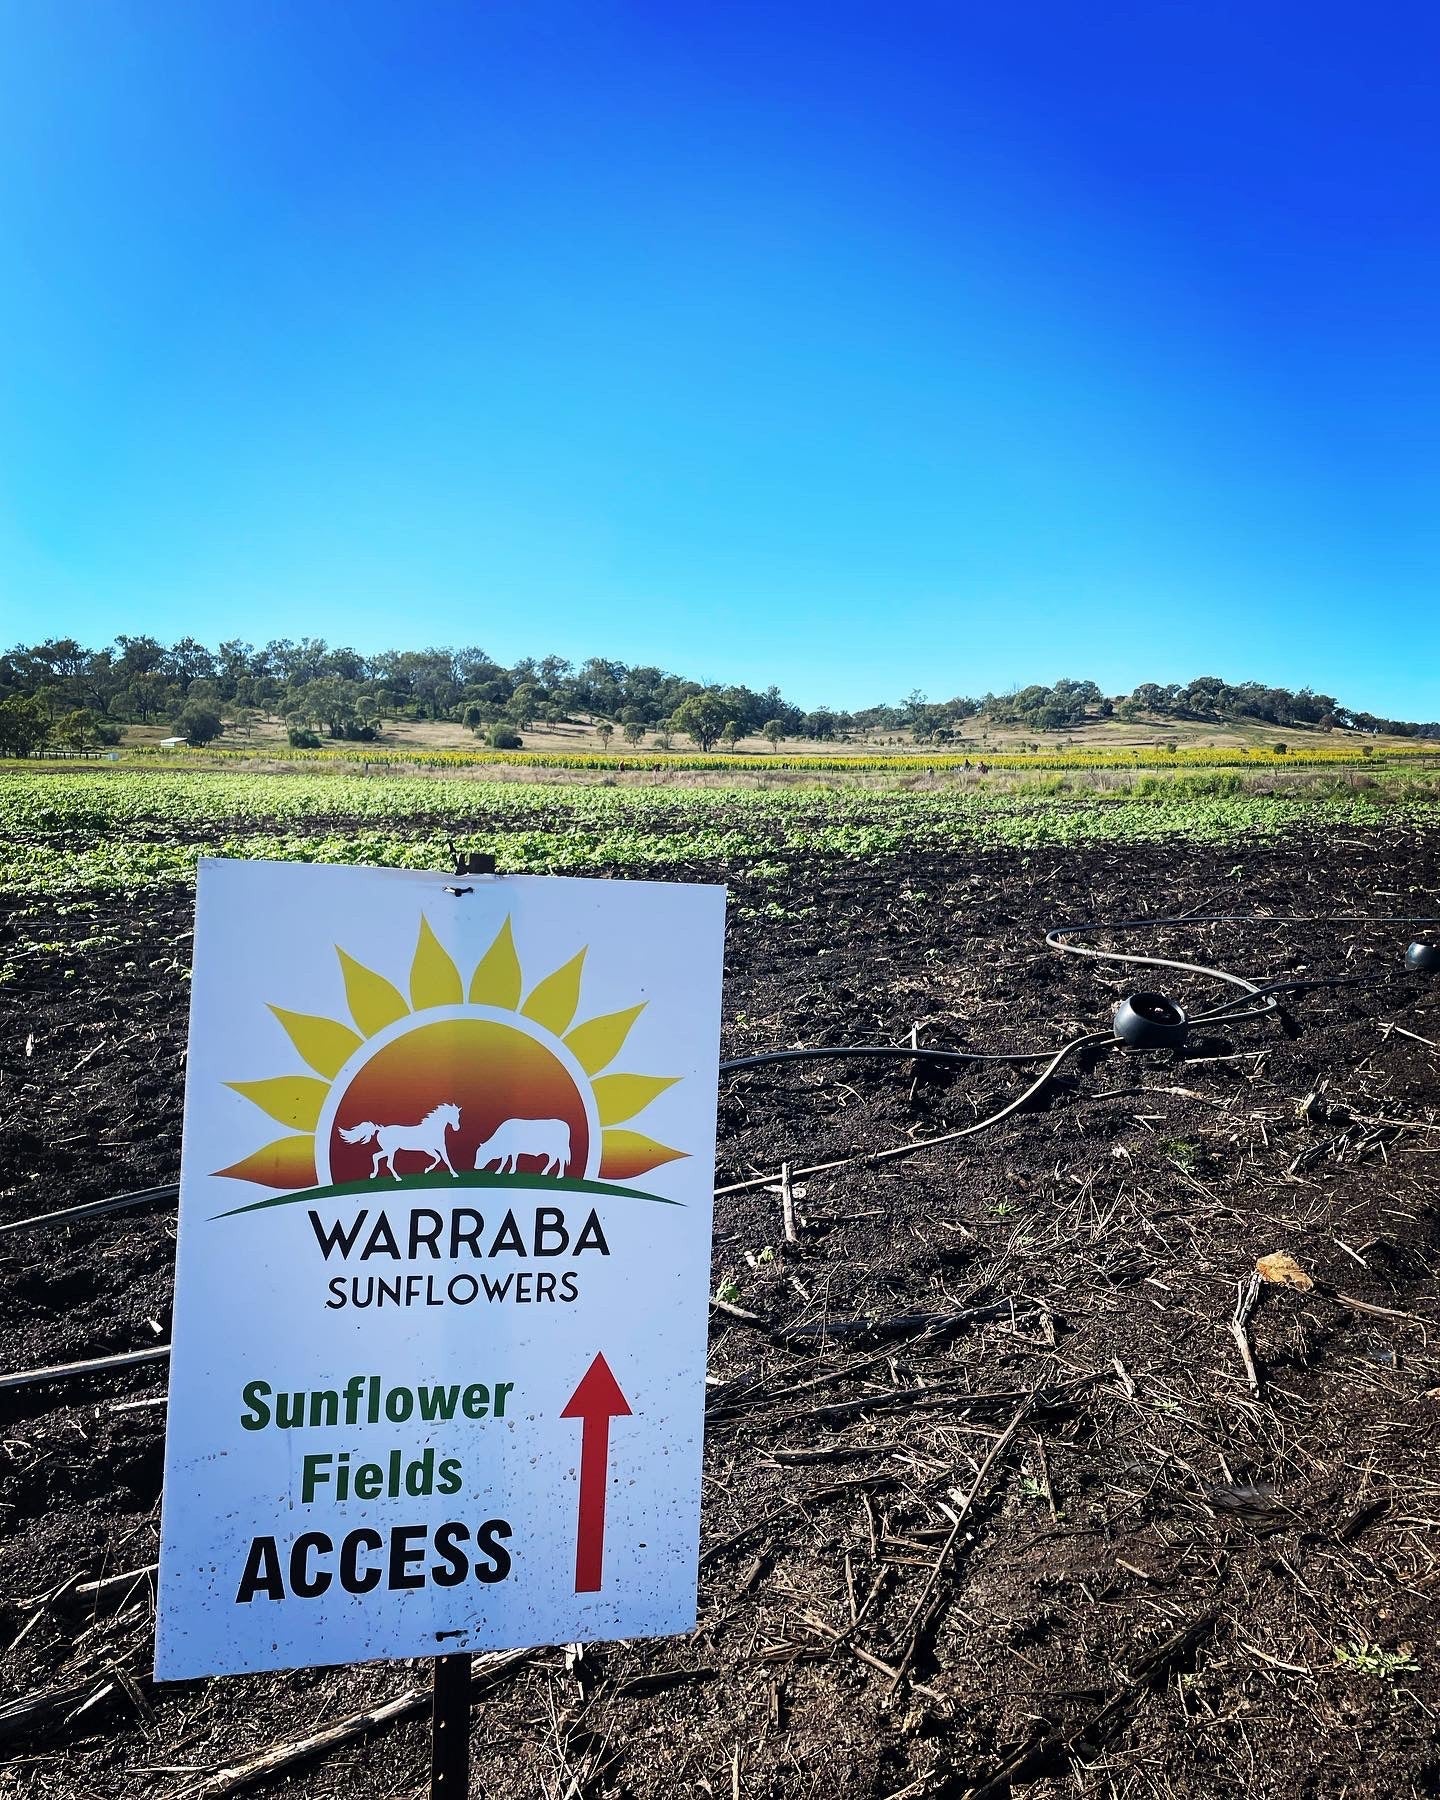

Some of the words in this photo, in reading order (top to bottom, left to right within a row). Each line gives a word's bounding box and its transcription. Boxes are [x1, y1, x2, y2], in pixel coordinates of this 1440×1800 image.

[308, 1207, 610, 1261] WARRABA
[327, 1272, 578, 1309] SUNFLOWERS
[240, 1375, 514, 1431] Sunflower
[301, 1448, 463, 1504] Fields
[235, 1519, 513, 1604] ACCESS
